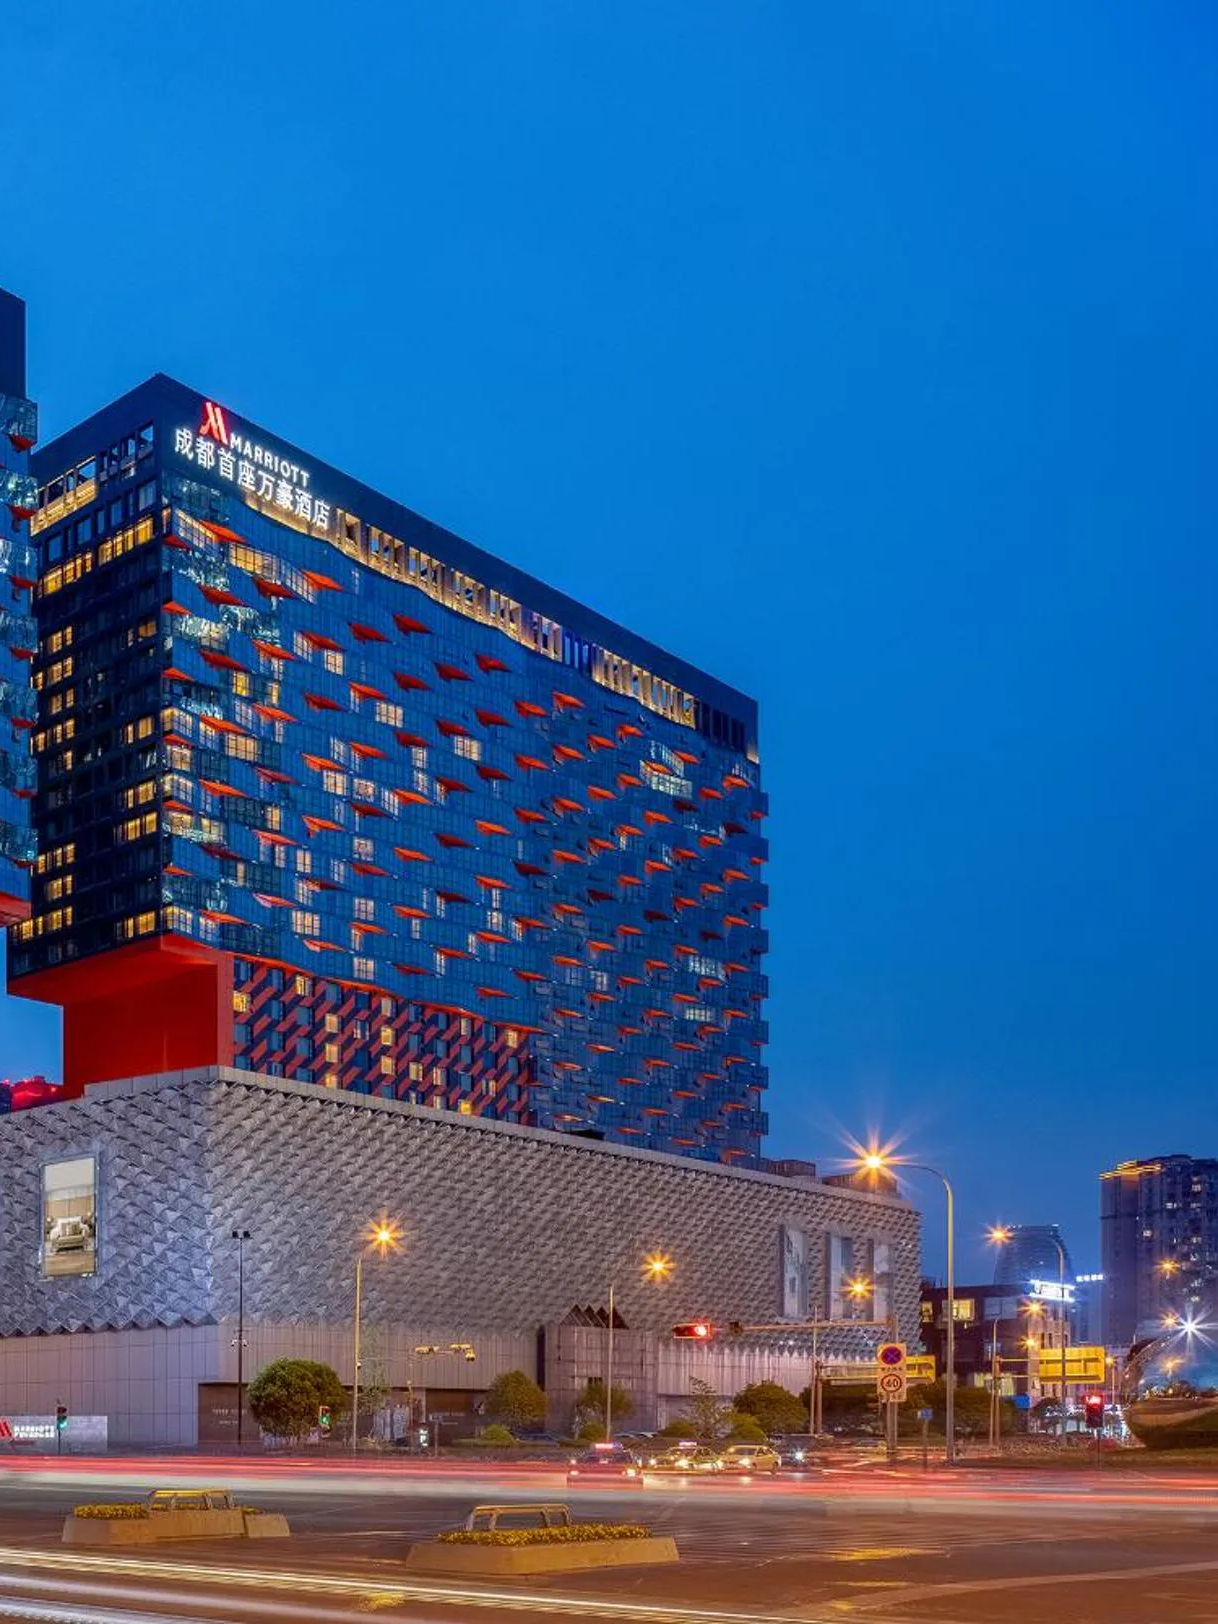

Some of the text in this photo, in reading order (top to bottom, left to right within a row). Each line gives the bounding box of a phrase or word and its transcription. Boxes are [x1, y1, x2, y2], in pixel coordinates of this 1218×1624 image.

[174, 428, 331, 530] 成都首座万豪酒店
[229, 432, 310, 488] MARRIOTT
[885, 1378, 899, 1388] 40
